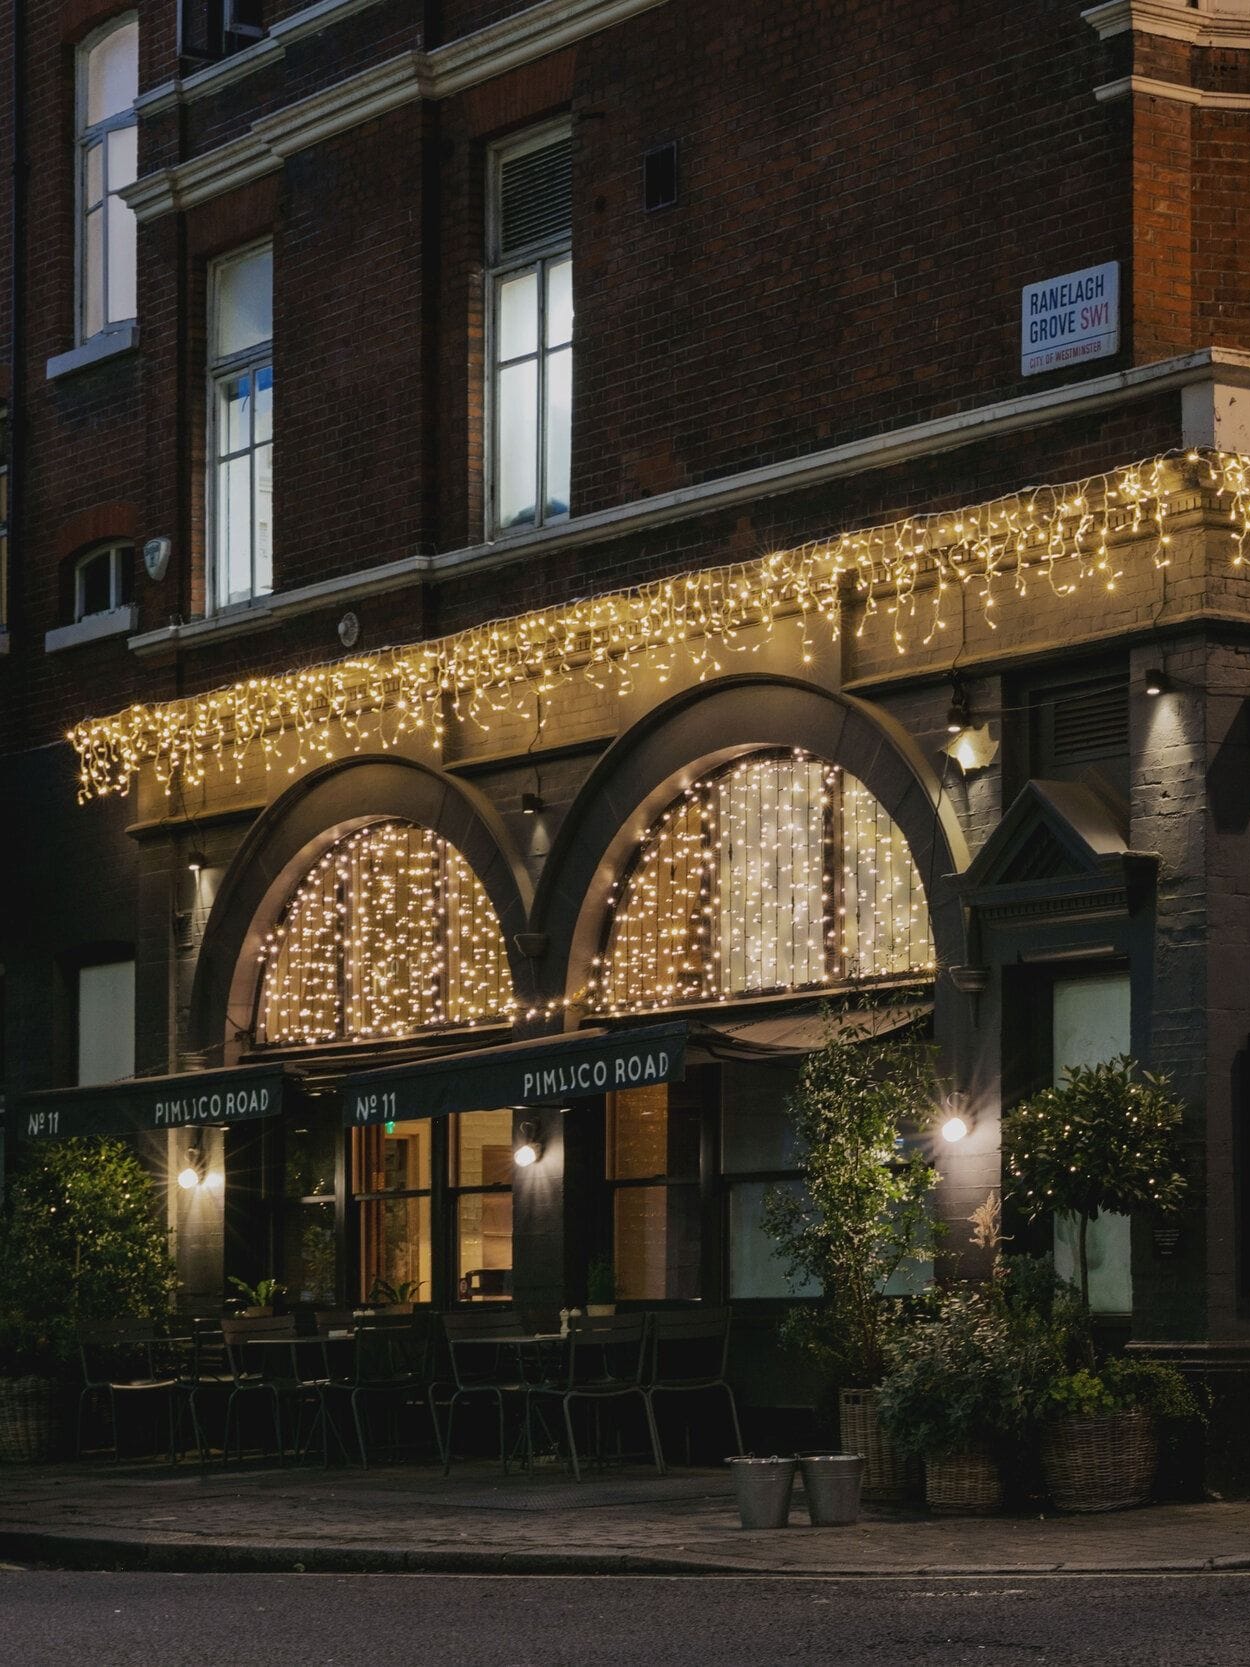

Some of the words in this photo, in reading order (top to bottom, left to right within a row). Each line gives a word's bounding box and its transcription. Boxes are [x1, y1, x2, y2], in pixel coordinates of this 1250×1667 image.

[1030, 274, 1105, 316] RANELAGH
[1029, 310, 1076, 344] GROVE
[1080, 302, 1109, 330] SW1
[1029, 357, 1043, 369] CITY
[1045, 352, 1054, 365] OF
[1055, 340, 1102, 361] WESTMINSTER
[381, 1091, 397, 1118] 11
[523, 1060, 607, 1098] PIMLICO
[615, 1051, 669, 1084] ROAD
[47, 1111, 59, 1134] 11
[155, 1094, 222, 1124] PIMLICO
[225, 1088, 269, 1115] ROAD
